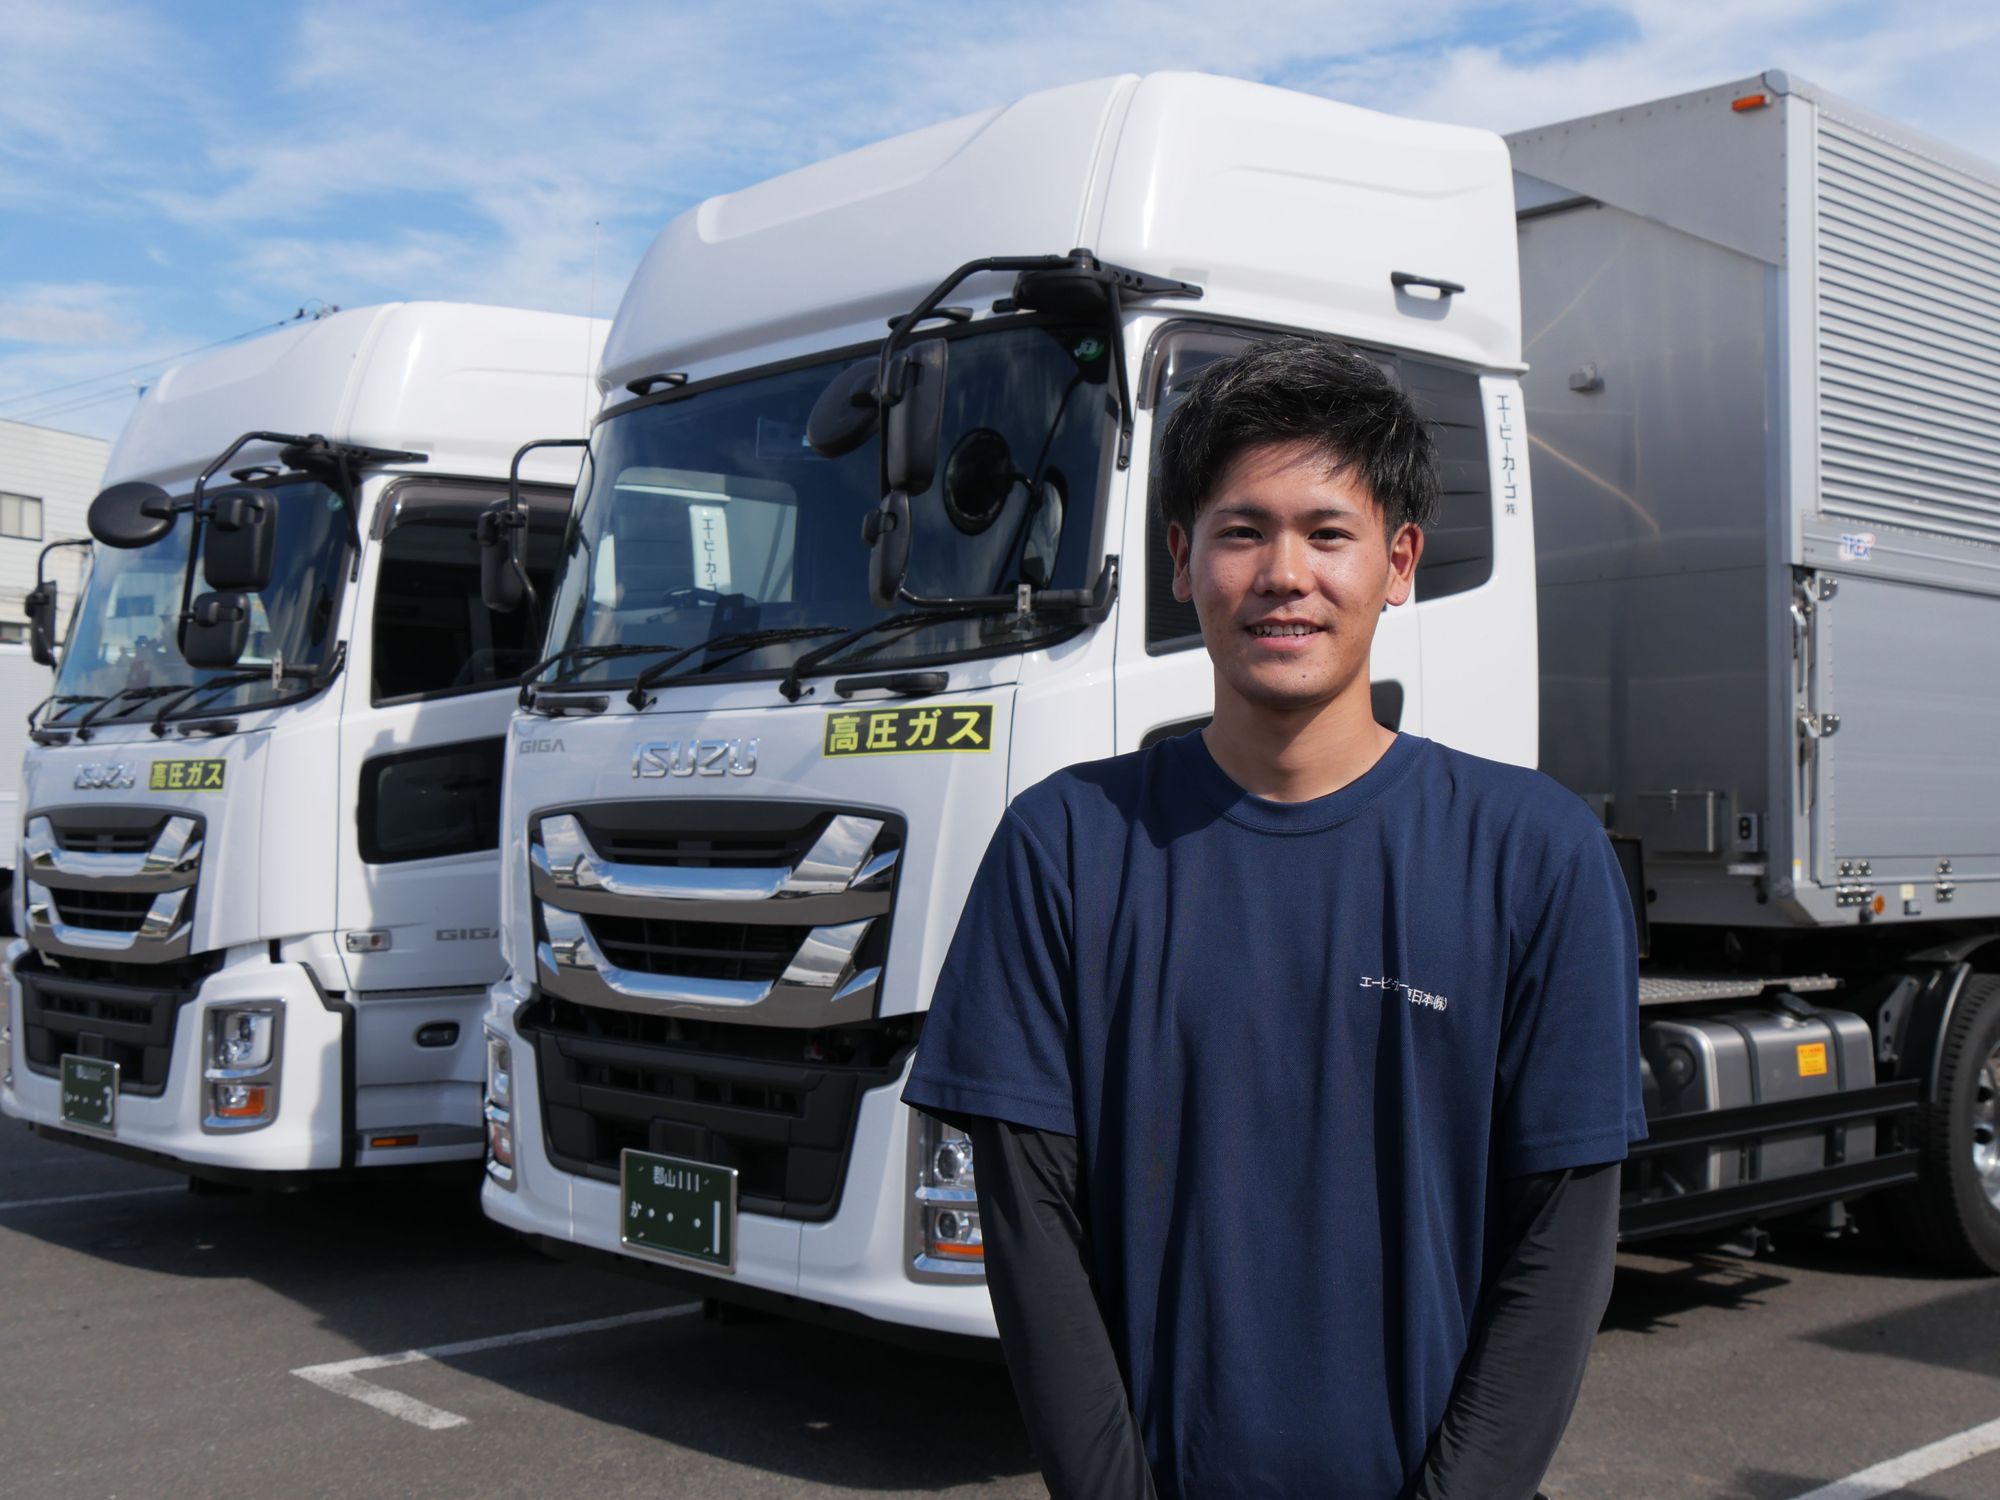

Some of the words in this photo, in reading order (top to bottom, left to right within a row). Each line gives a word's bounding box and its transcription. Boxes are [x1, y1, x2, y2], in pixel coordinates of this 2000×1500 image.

[519, 738, 566, 755] GIGA
[829, 707, 984, 753] 高圧ガス
[151, 761, 222, 789] 高圧ガス
[631, 737, 761, 779] ISUZU
